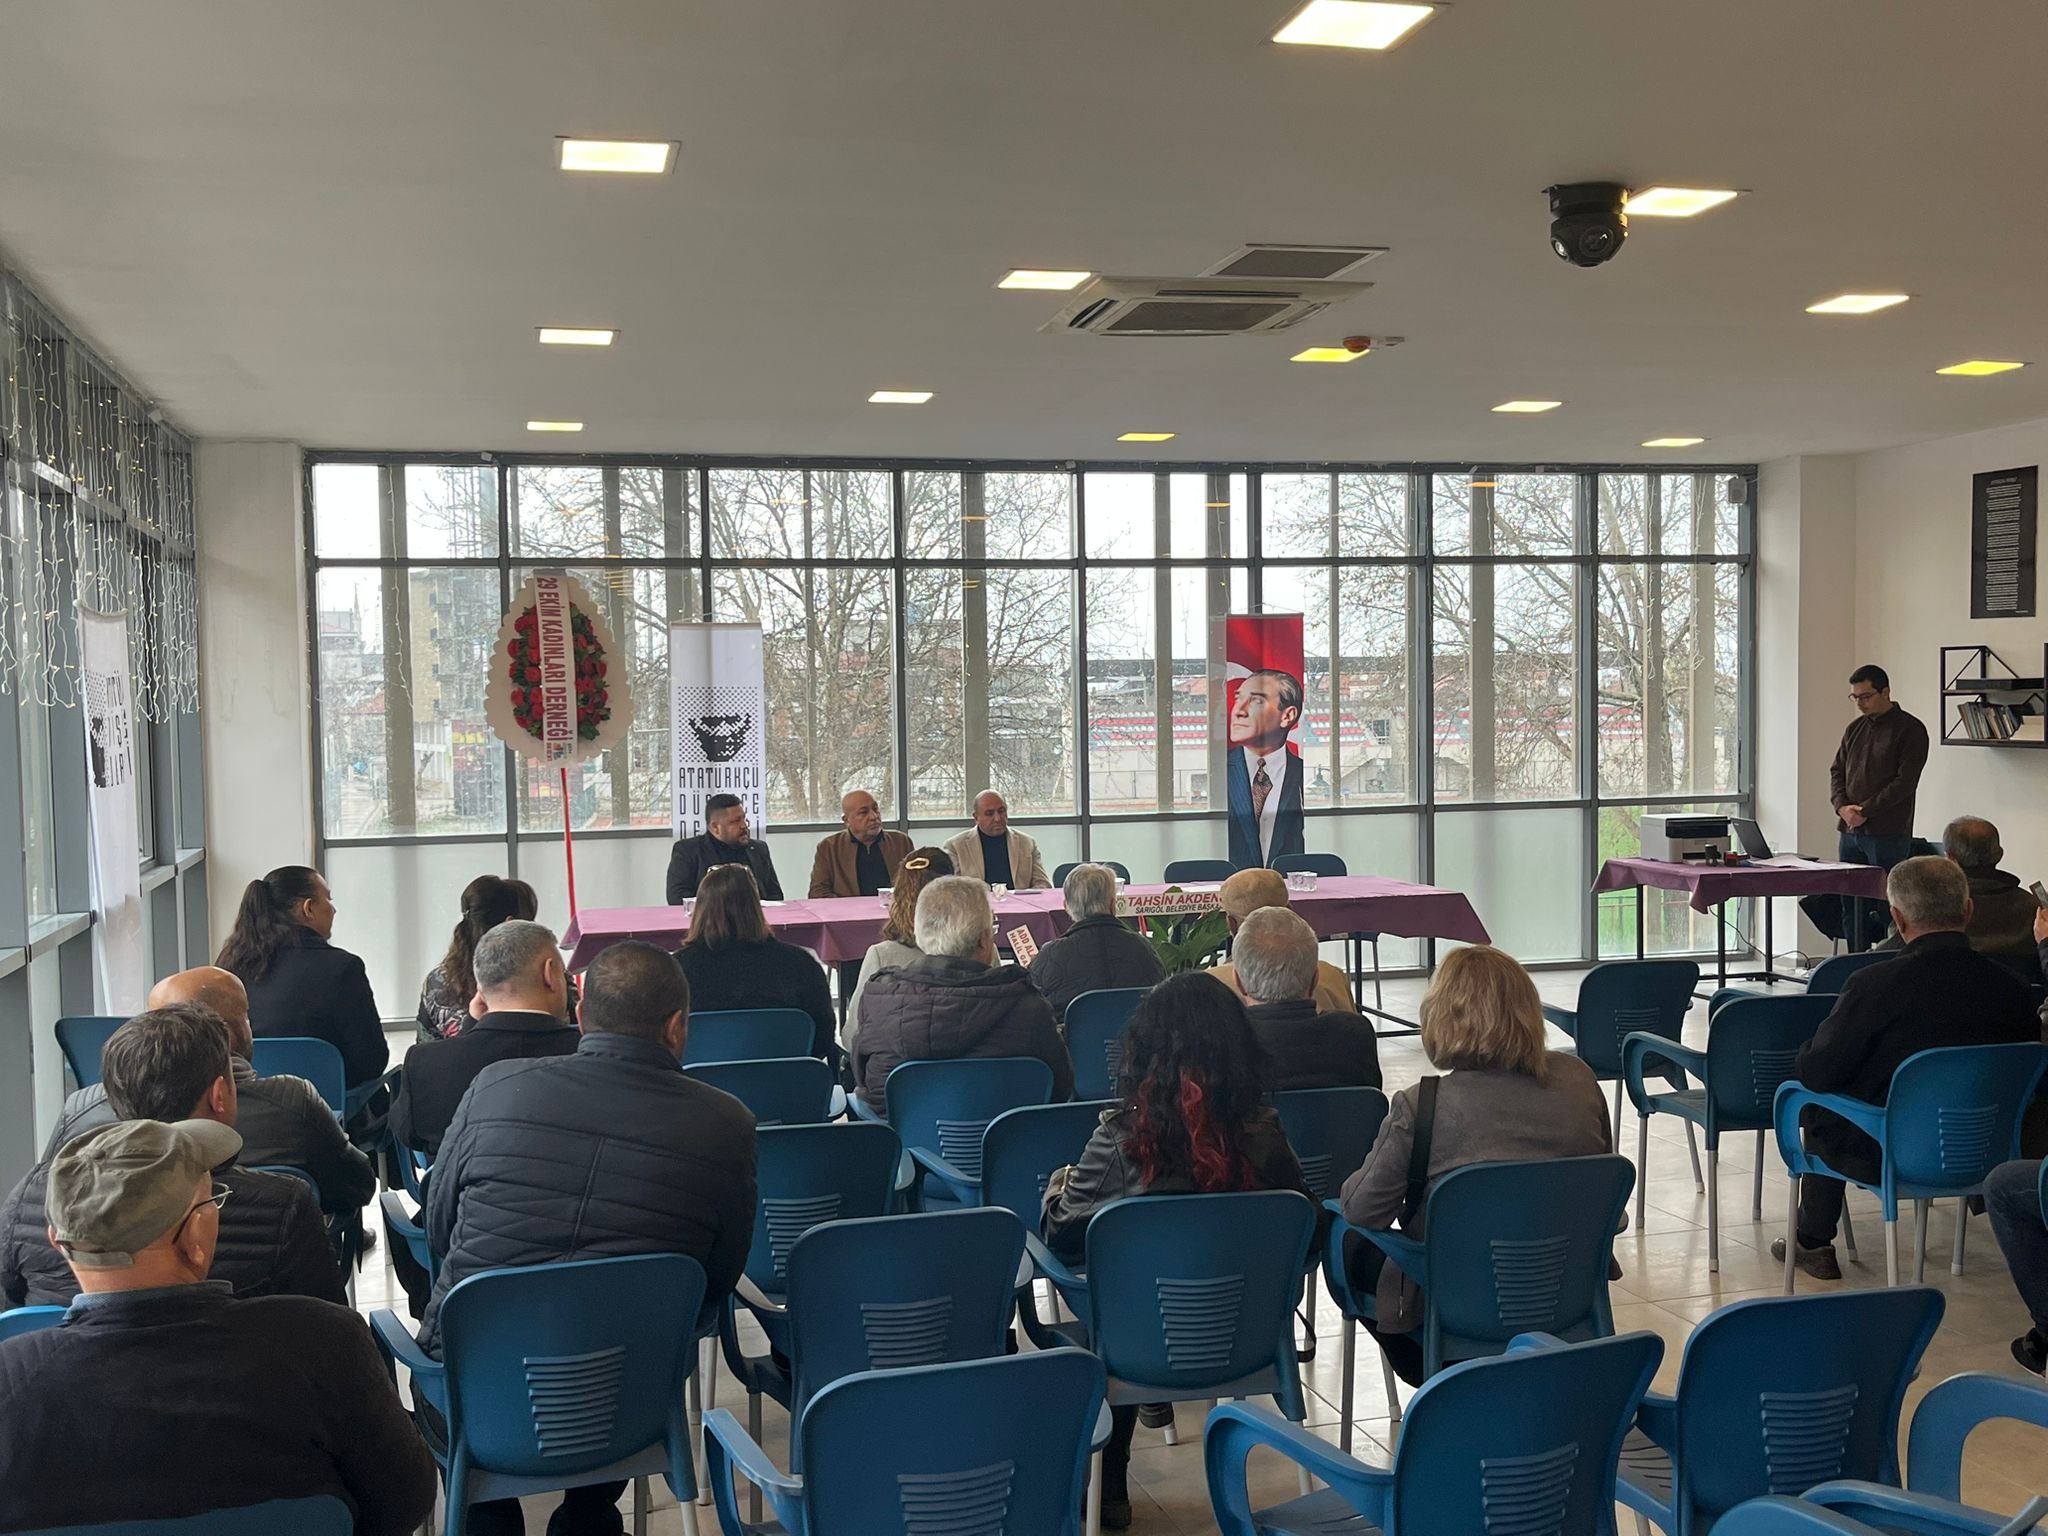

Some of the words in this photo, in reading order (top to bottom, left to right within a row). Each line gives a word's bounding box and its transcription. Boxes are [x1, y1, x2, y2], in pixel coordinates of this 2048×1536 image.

[537, 577, 558, 589] 29
[539, 592, 566, 616] EKİM
[542, 620, 567, 683] KADINLARI
[545, 687, 573, 741] DERNEĞİ
[679, 763, 759, 790] ATATÜRKÇÜ
[1128, 893, 1174, 907] TAHSİN
[1176, 892, 1222, 905] AKDEN
[1135, 905, 1165, 914] SARIGÖL
[1166, 904, 1196, 913] BELEDİYE
[1197, 902, 1222, 911] BAŞKA
[1017, 929, 1030, 945] ADD
